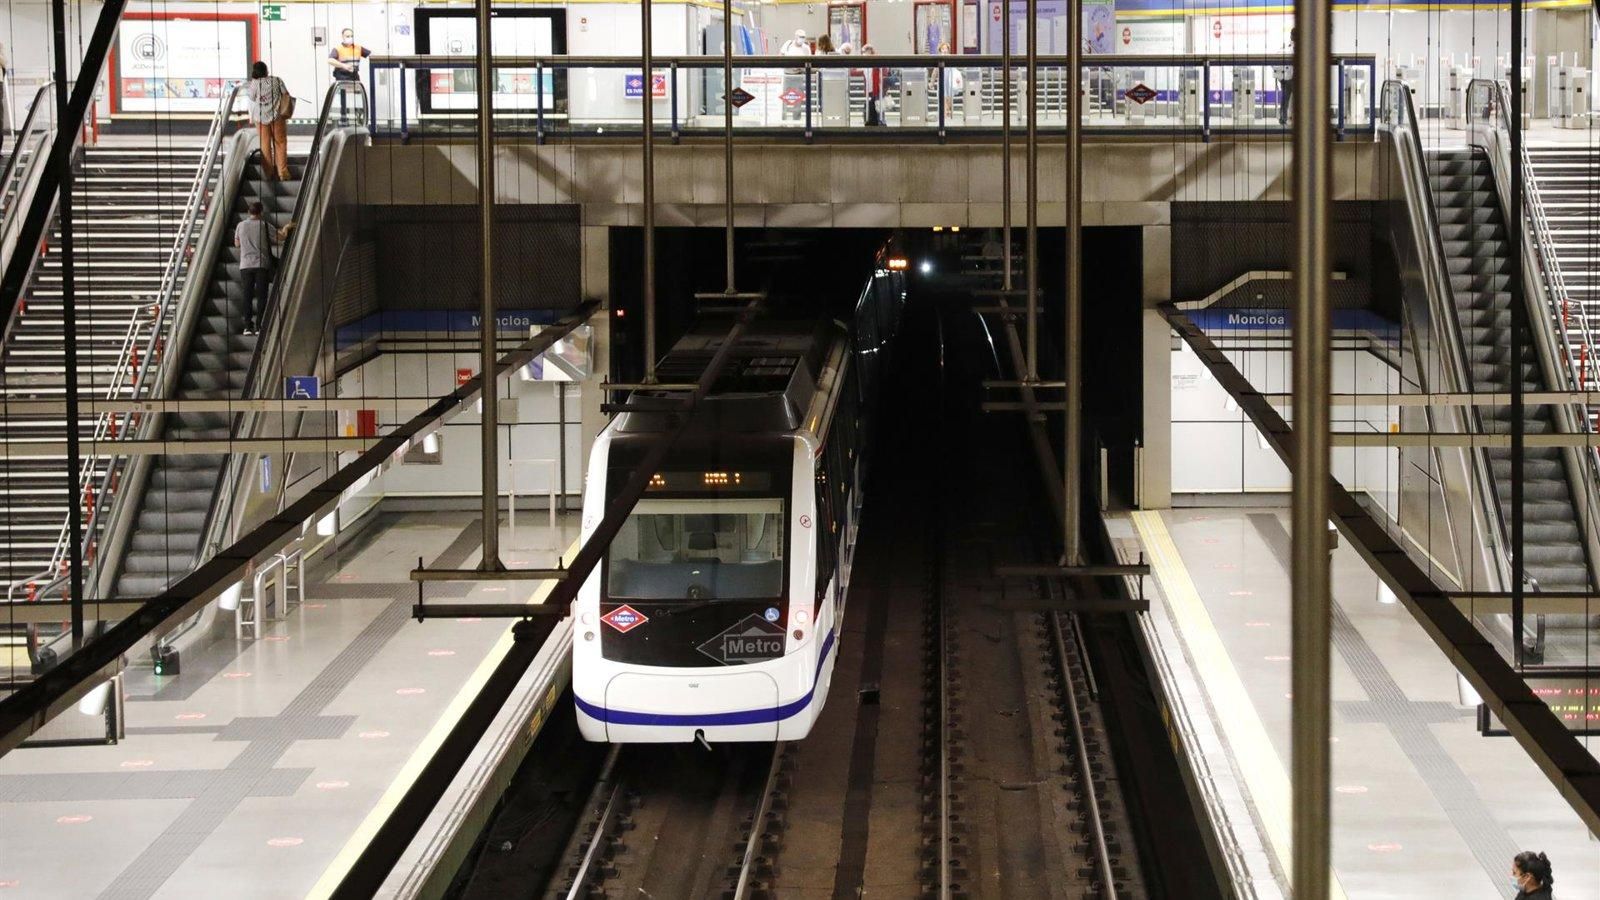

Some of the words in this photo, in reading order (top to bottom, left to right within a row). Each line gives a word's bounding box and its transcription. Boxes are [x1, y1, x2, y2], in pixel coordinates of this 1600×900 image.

[471, 314, 530, 327] Mncloa
[1228, 313, 1285, 325] Moncloa
[614, 615, 635, 623] Metro
[728, 639, 781, 654] Metro
